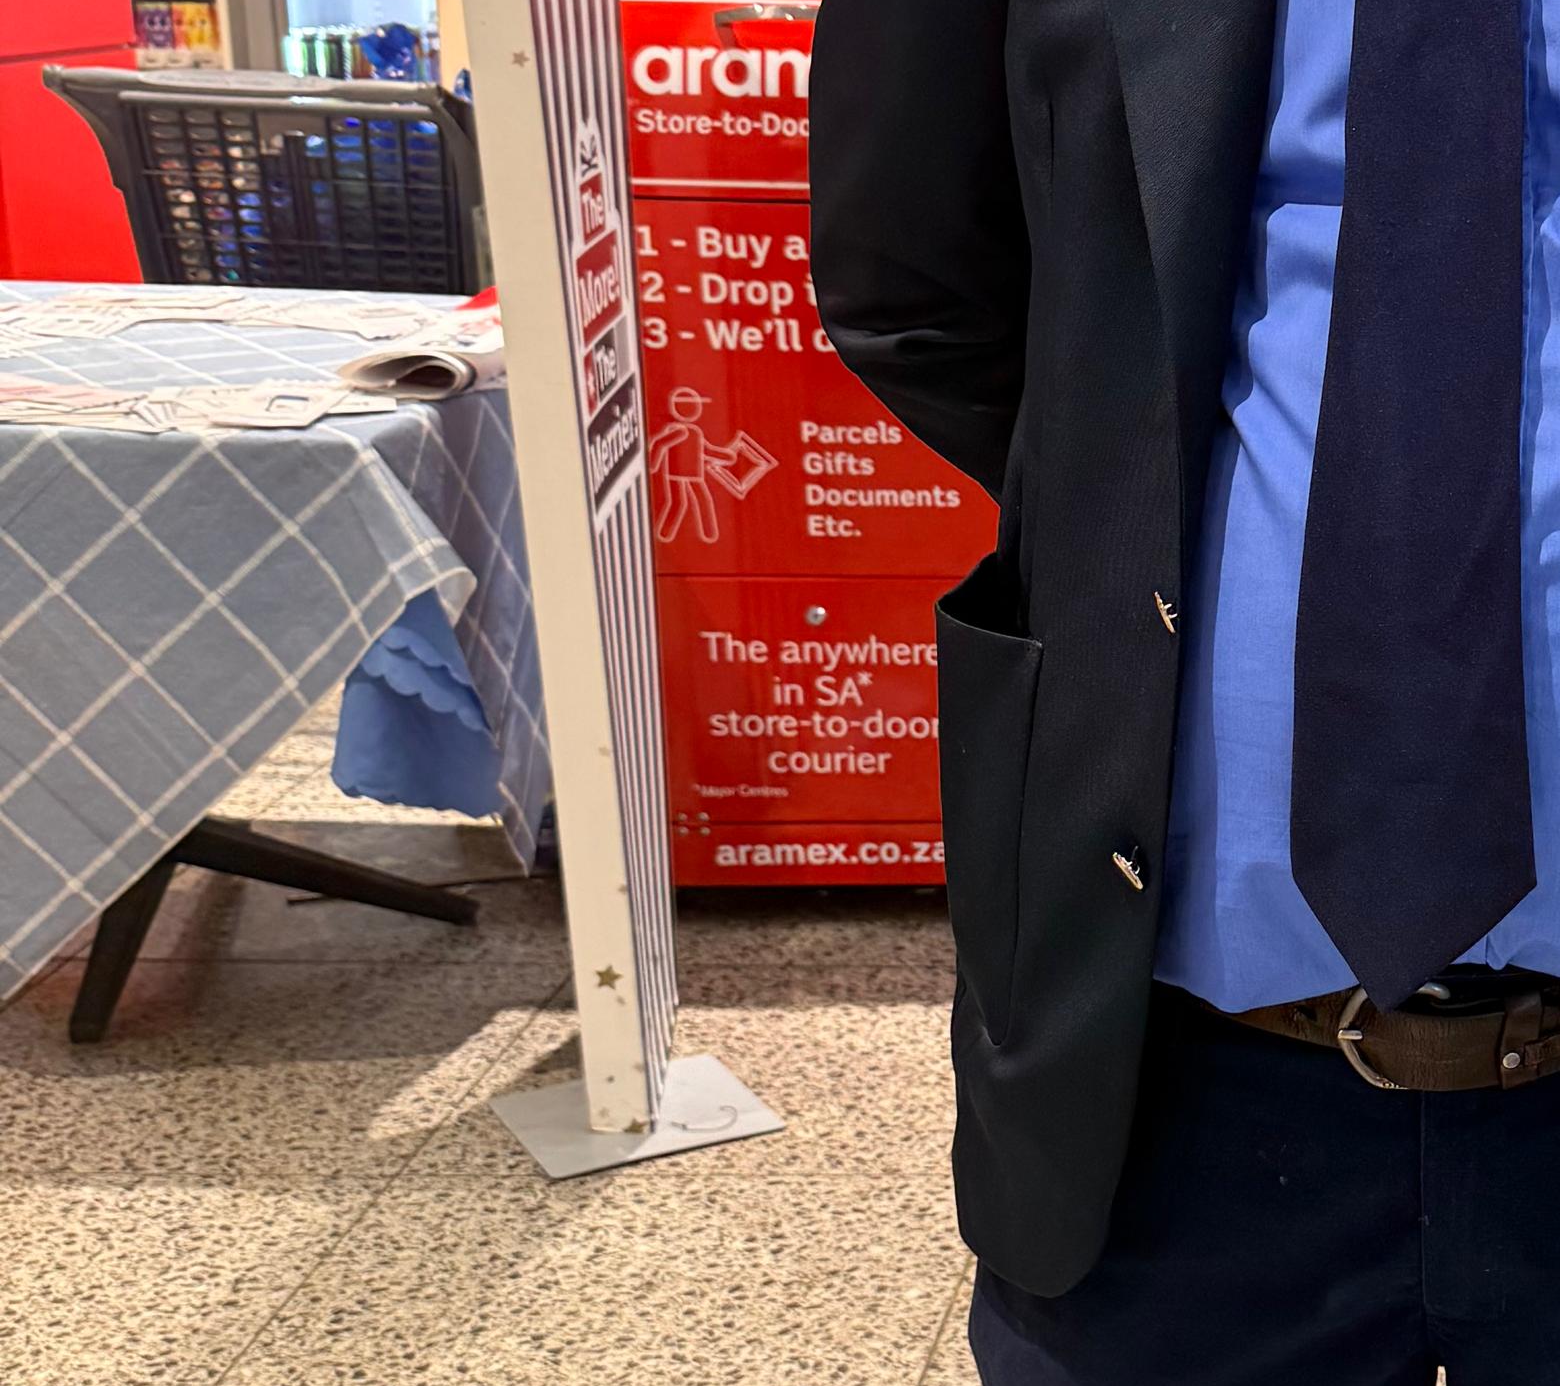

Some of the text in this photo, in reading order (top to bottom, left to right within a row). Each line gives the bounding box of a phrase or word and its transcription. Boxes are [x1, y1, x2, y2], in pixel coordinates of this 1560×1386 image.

[582, 188, 604, 234] The
[635, 225, 659, 256] 1
[697, 226, 772, 269] Buy
[783, 235, 809, 260] a
[640, 271, 666, 302] 2
[700, 272, 794, 315] Drop
[643, 317, 668, 349] 3
[703, 318, 803, 352] We'll
[595, 344, 617, 393] The
[800, 421, 902, 446] Parcels
[803, 452, 875, 476] Gifts
[805, 484, 961, 508] Documents
[807, 514, 862, 538] Etc.
[700, 631, 938, 671] The anywhere
[773, 677, 804, 707] in
[768, 746, 892, 774] courier
[715, 840, 945, 867] aramex.co.za
